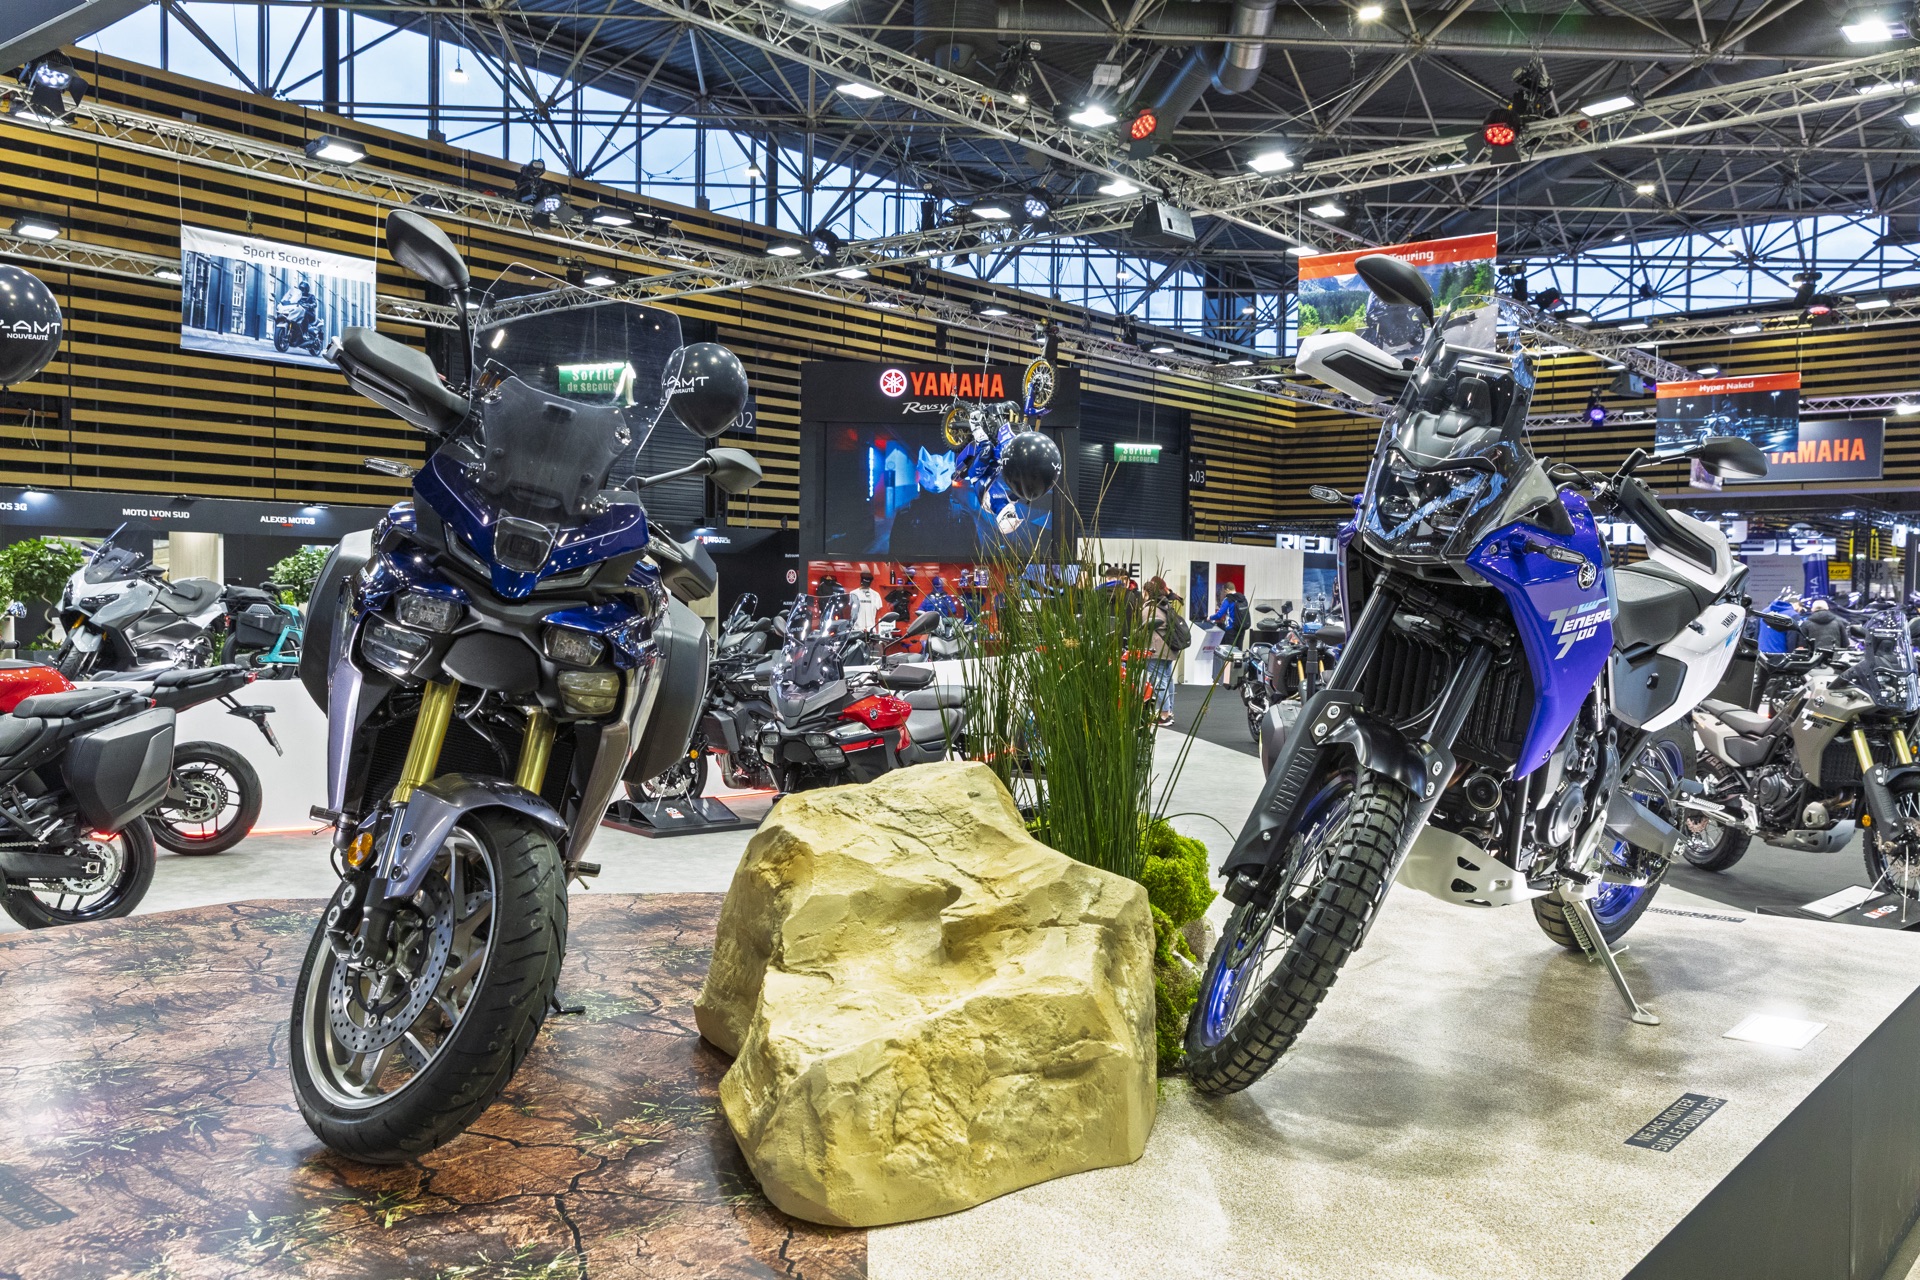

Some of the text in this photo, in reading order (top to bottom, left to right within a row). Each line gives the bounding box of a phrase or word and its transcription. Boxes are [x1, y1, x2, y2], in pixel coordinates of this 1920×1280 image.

[243, 246, 321, 267] Sport Scooter
[0, 319, 60, 335] -AMT
[572, 368, 615, 382] Sortie
[567, 382, 578, 392] de
[910, 372, 1005, 397] YAMAHA
[1699, 381, 1754, 392] Hyper Naked
[1123, 447, 1152, 455] Sortie
[1771, 437, 1866, 464] YAMAHA
[14, 502, 28, 511] 3G
[122, 508, 190, 519] MOTO LYON SUD
[260, 516, 315, 525] ALEXIS MOTOS
[1276, 533, 1337, 554] RIEJU
[1554, 625, 1598, 661] 700
[1269, 746, 1317, 815] YAMAHA
[1634, 1098, 1698, 1142] NE PAS MONTER
[1650, 1096, 1724, 1152] SUR LE PODIUM SVP
